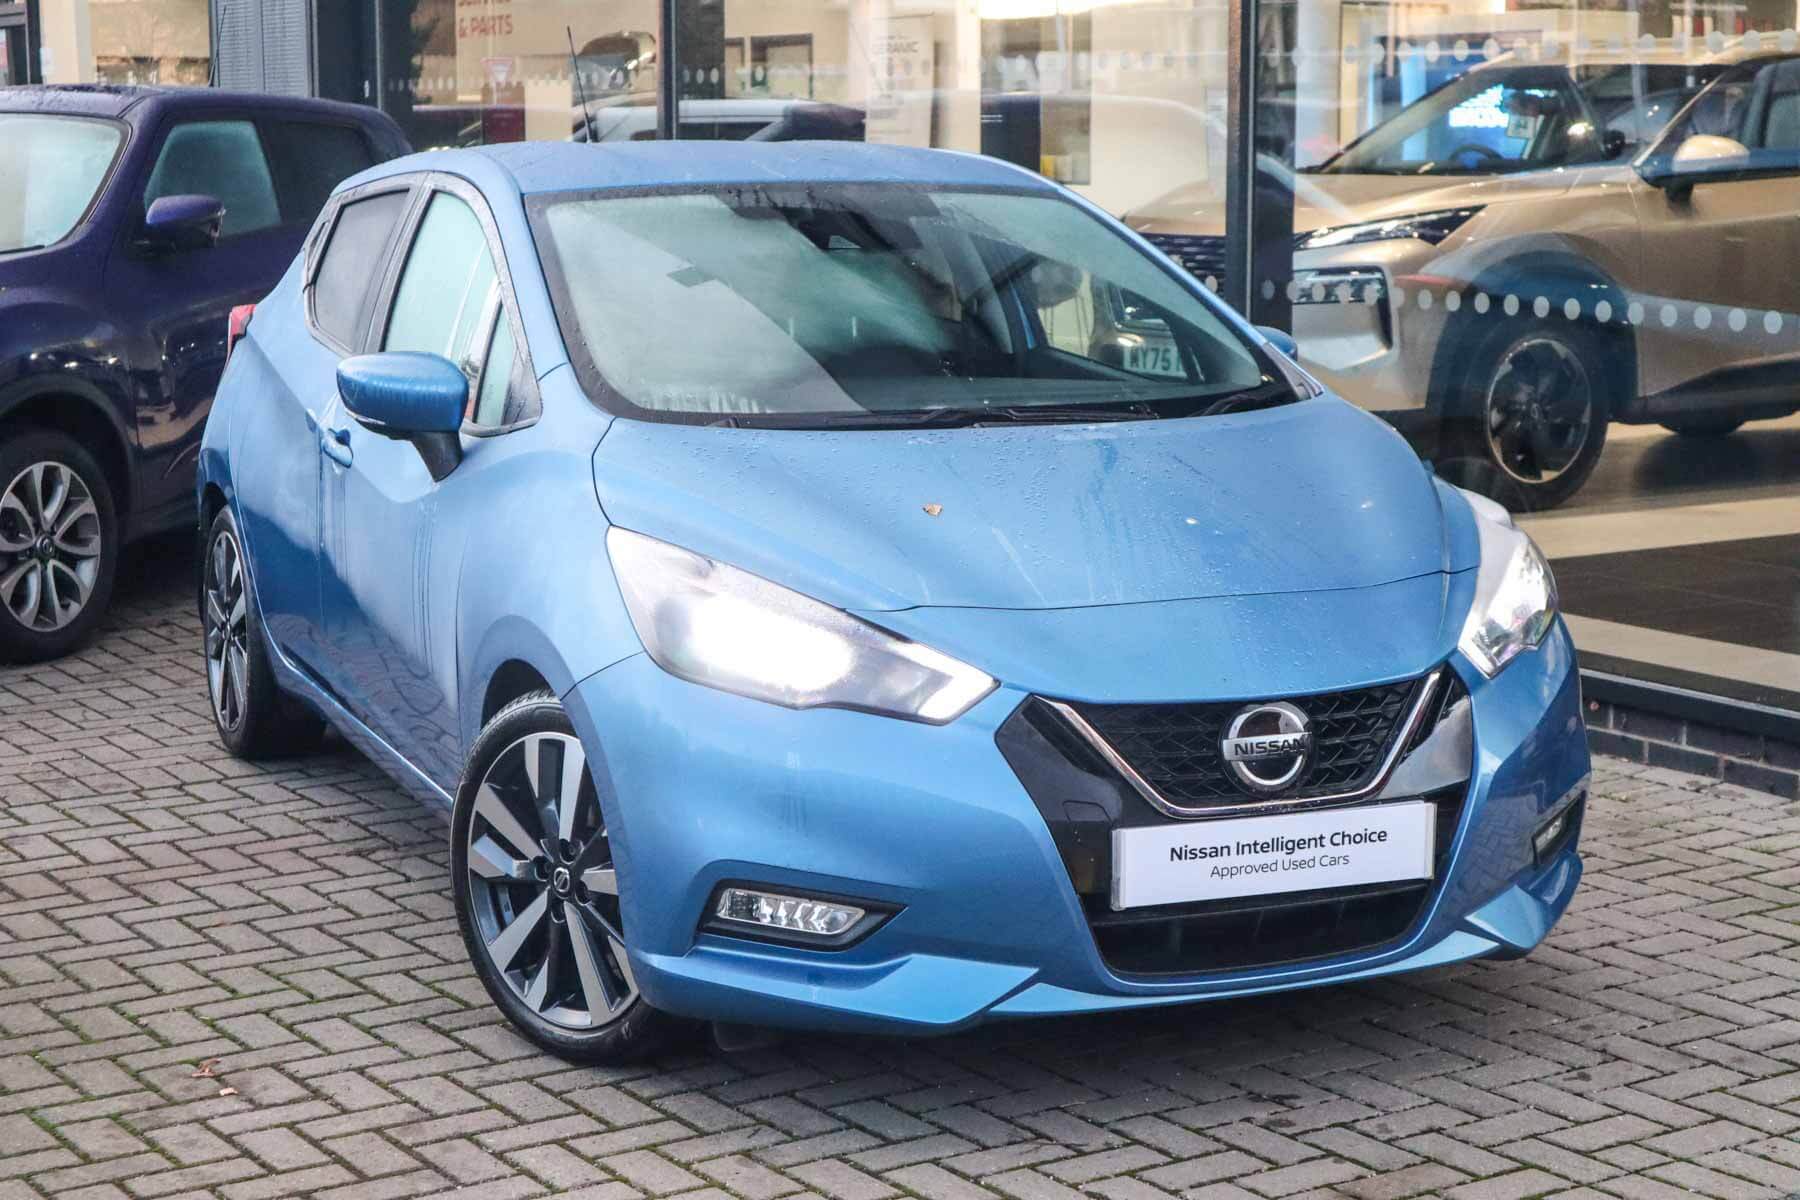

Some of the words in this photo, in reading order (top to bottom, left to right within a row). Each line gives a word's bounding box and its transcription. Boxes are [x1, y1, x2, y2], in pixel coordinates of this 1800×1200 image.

[470, 14, 512, 35] PARTS
[1234, 739, 1306, 756] NISSAN
[1170, 844, 1231, 862] Nissan
[1236, 836, 1326, 855] Intelligent
[1330, 828, 1388, 847] Choice
[1209, 859, 1278, 880] Approved
[1281, 856, 1317, 871] Used
[1319, 854, 1350, 867] Cars
